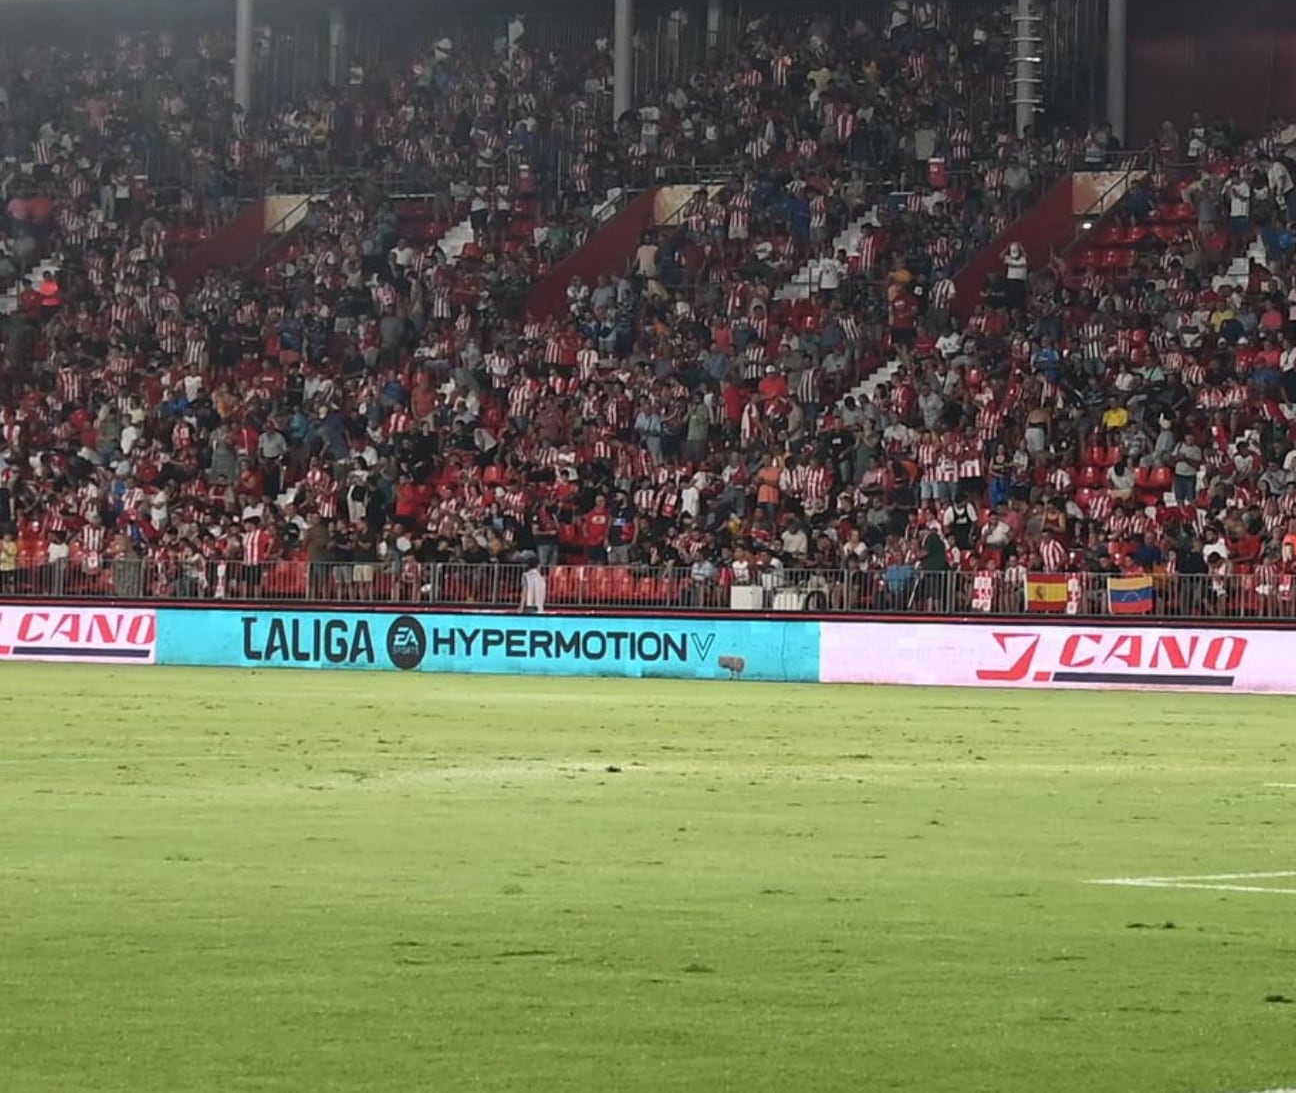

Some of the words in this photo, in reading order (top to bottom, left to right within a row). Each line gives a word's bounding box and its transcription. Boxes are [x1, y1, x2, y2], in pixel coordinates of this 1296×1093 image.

[17, 613, 156, 645] CANO
[241, 617, 375, 663] LALIGA
[394, 627, 419, 645] EA
[1060, 634, 1248, 670] CANO
